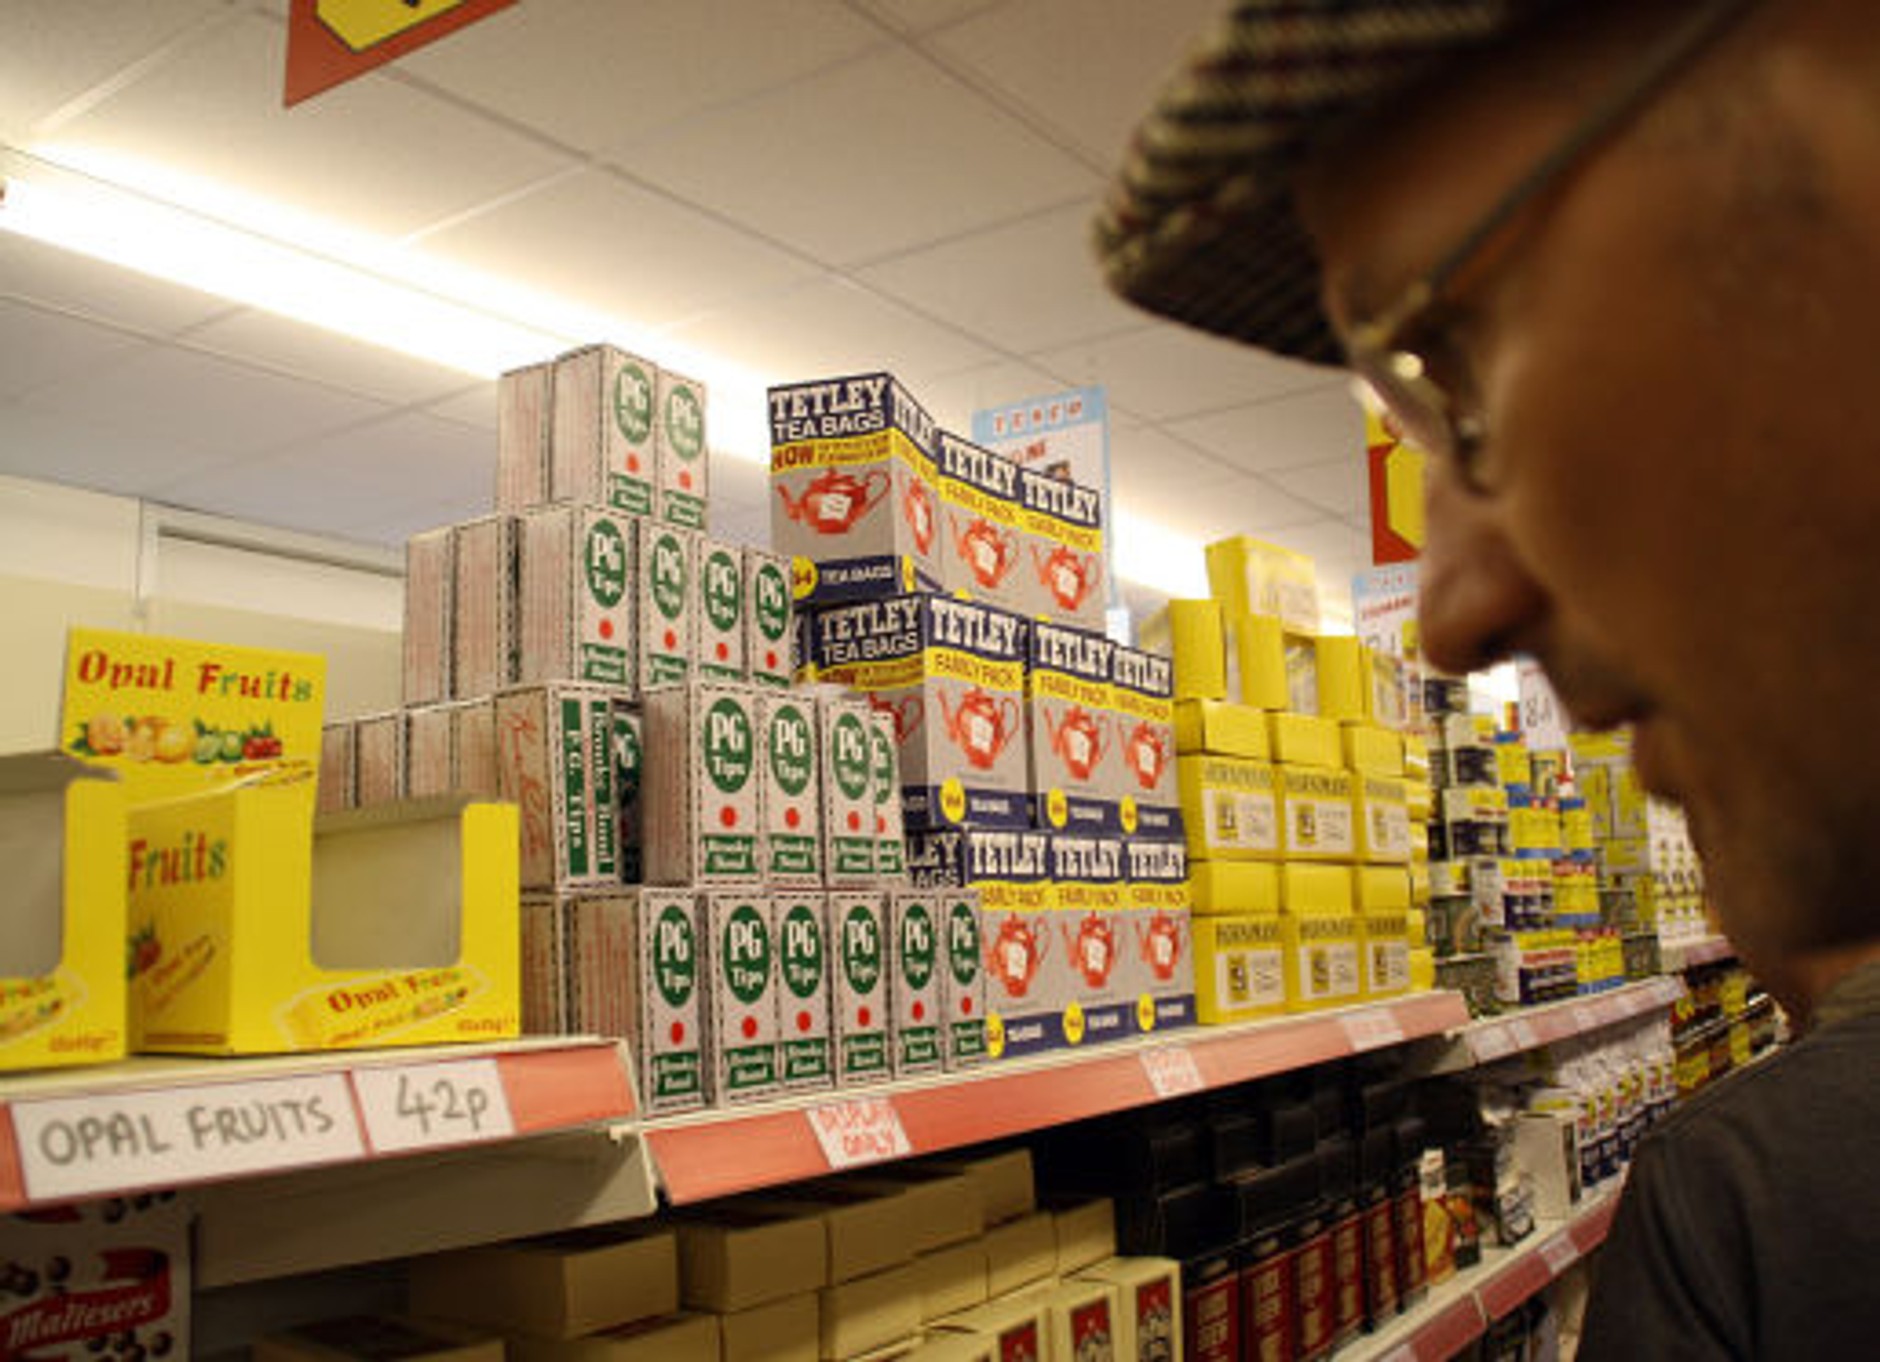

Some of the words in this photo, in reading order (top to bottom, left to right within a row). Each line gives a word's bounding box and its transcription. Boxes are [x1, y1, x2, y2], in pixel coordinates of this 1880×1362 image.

[770, 378, 886, 419] TETLEY
[774, 420, 818, 442] TEA
[821, 410, 885, 436] BAGS
[942, 434, 1017, 498] TETLEY
[1022, 471, 1097, 523] TETLEY
[593, 533, 623, 571] PG
[657, 548, 681, 585] PG
[708, 562, 736, 598] PG
[759, 574, 784, 610] PG
[819, 599, 920, 640] TETLEY
[930, 598, 1016, 656] TETLEY
[822, 641, 859, 666] TEA
[861, 632, 918, 658] BAGS
[1036, 626, 1113, 679] TETLEY
[78, 650, 175, 691] Opal
[198, 662, 312, 702] Fruits
[934, 652, 980, 678] FAMILY
[982, 663, 1015, 688] PACK
[711, 711, 746, 752] PG
[776, 719, 805, 757] PG
[838, 727, 864, 762] PG
[712, 755, 746, 781] Tips
[127, 830, 229, 893] Fruits
[969, 831, 1046, 875] TETLEY
[1052, 837, 1122, 878] TETLEY
[1128, 842, 1186, 879] TETLEY
[660, 919, 689, 964] PG
[729, 919, 761, 965] PG
[787, 919, 816, 959] PG
[846, 919, 874, 956] PG
[905, 917, 929, 954] PG
[952, 916, 973, 951] PG
[661, 966, 691, 994] Tips
[731, 966, 765, 991] Tips
[395, 1075, 489, 1134] 42p
[39, 1112, 171, 1166] OPAL
[188, 1094, 336, 1152] FRUITS
